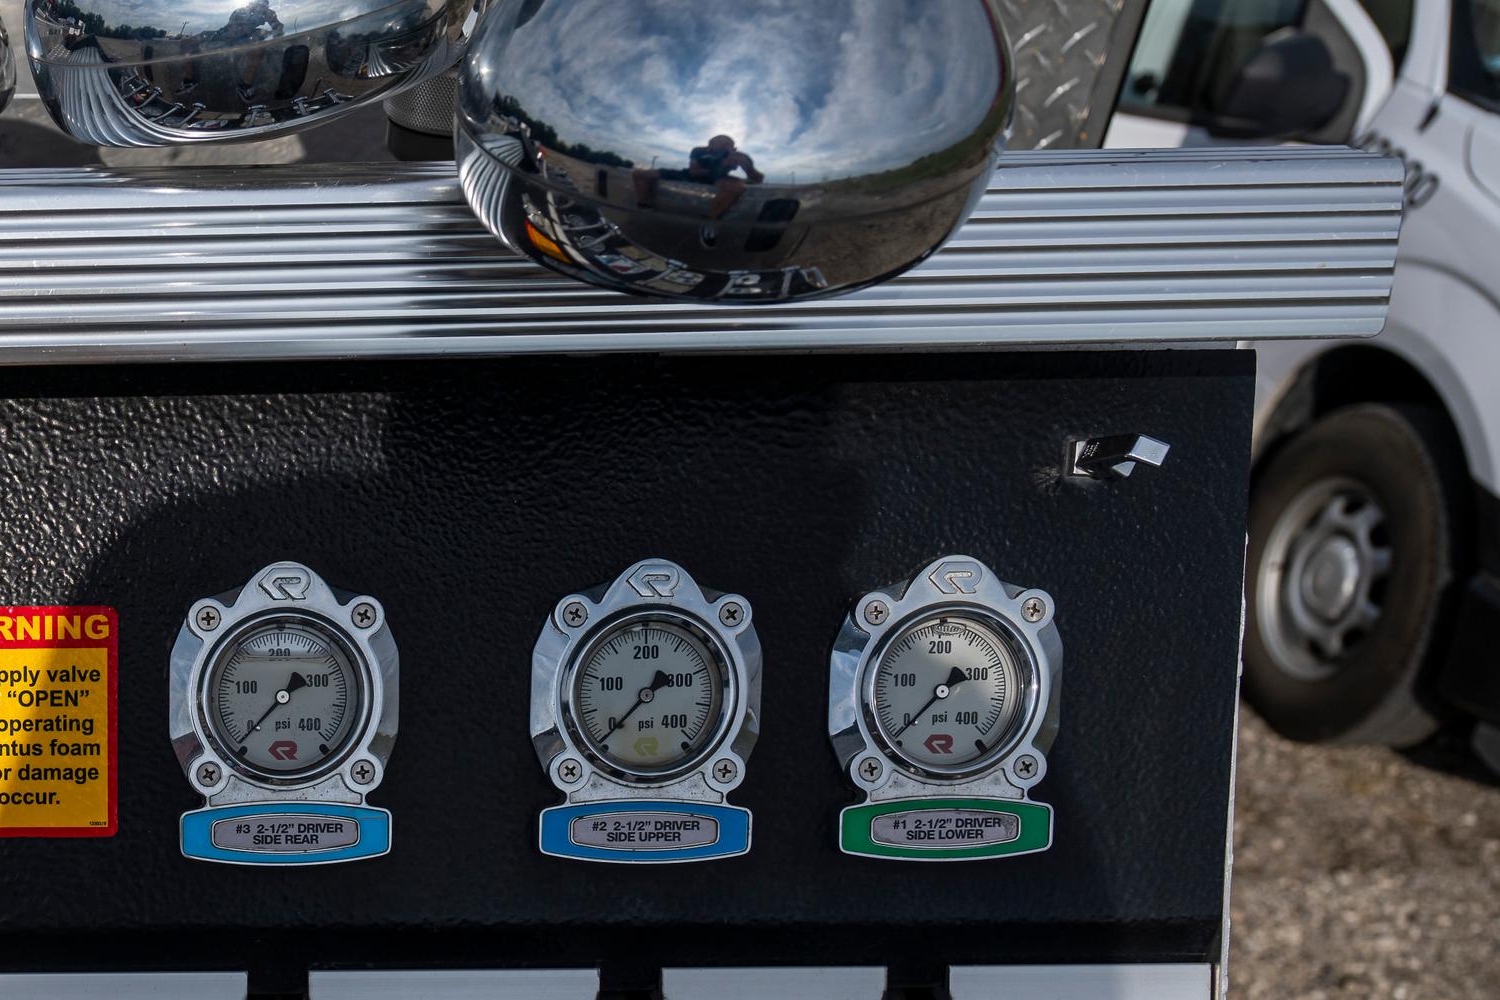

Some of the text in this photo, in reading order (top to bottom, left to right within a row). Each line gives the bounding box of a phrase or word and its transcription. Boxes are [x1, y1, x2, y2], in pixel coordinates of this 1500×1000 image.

[46, 666, 100, 684] valve
[48, 740, 100, 757] foam
[17, 763, 100, 786] damage
[235, 824, 252, 834] #3
[297, 822, 344, 834] DRIVER
[592, 820, 610, 832] #2
[654, 820, 700, 832] DRIVER
[892, 818, 910, 830] #1
[954, 817, 1001, 830] DRIVER
[252, 834, 320, 845] SIDE REAR
[606, 830, 682, 842] SIDE UPPER
[906, 828, 984, 841] SIDE LOWER
